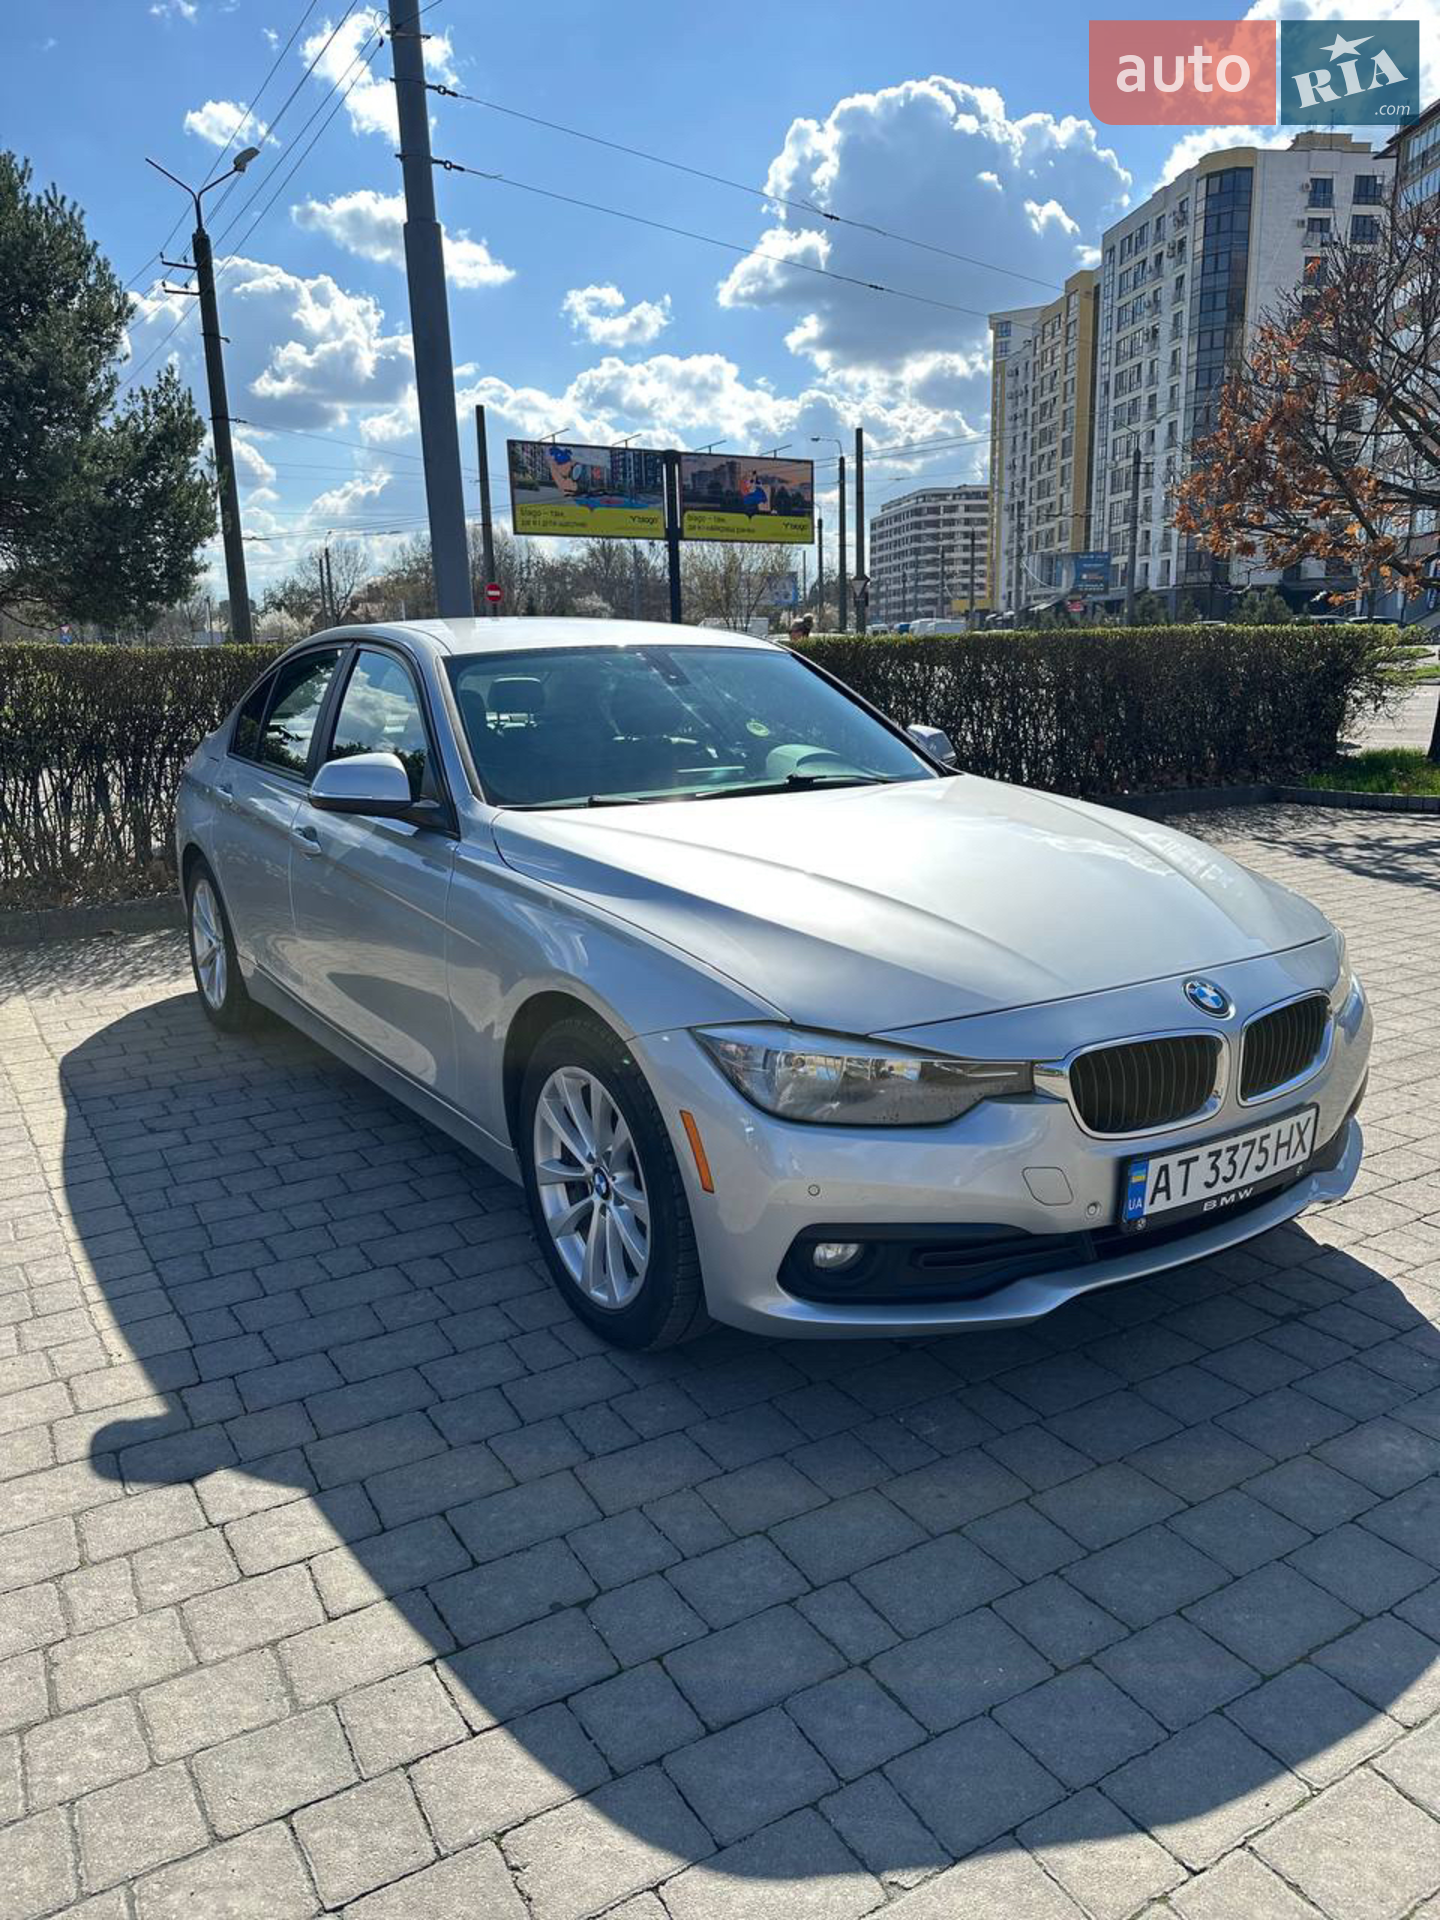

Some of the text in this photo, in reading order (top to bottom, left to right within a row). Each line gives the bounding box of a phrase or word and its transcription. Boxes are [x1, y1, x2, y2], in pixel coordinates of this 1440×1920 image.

[1149, 1116, 1311, 1206] AT 3375 HX
[1128, 1197, 1143, 1211] UA
[1202, 1187, 1254, 1212] BMW
